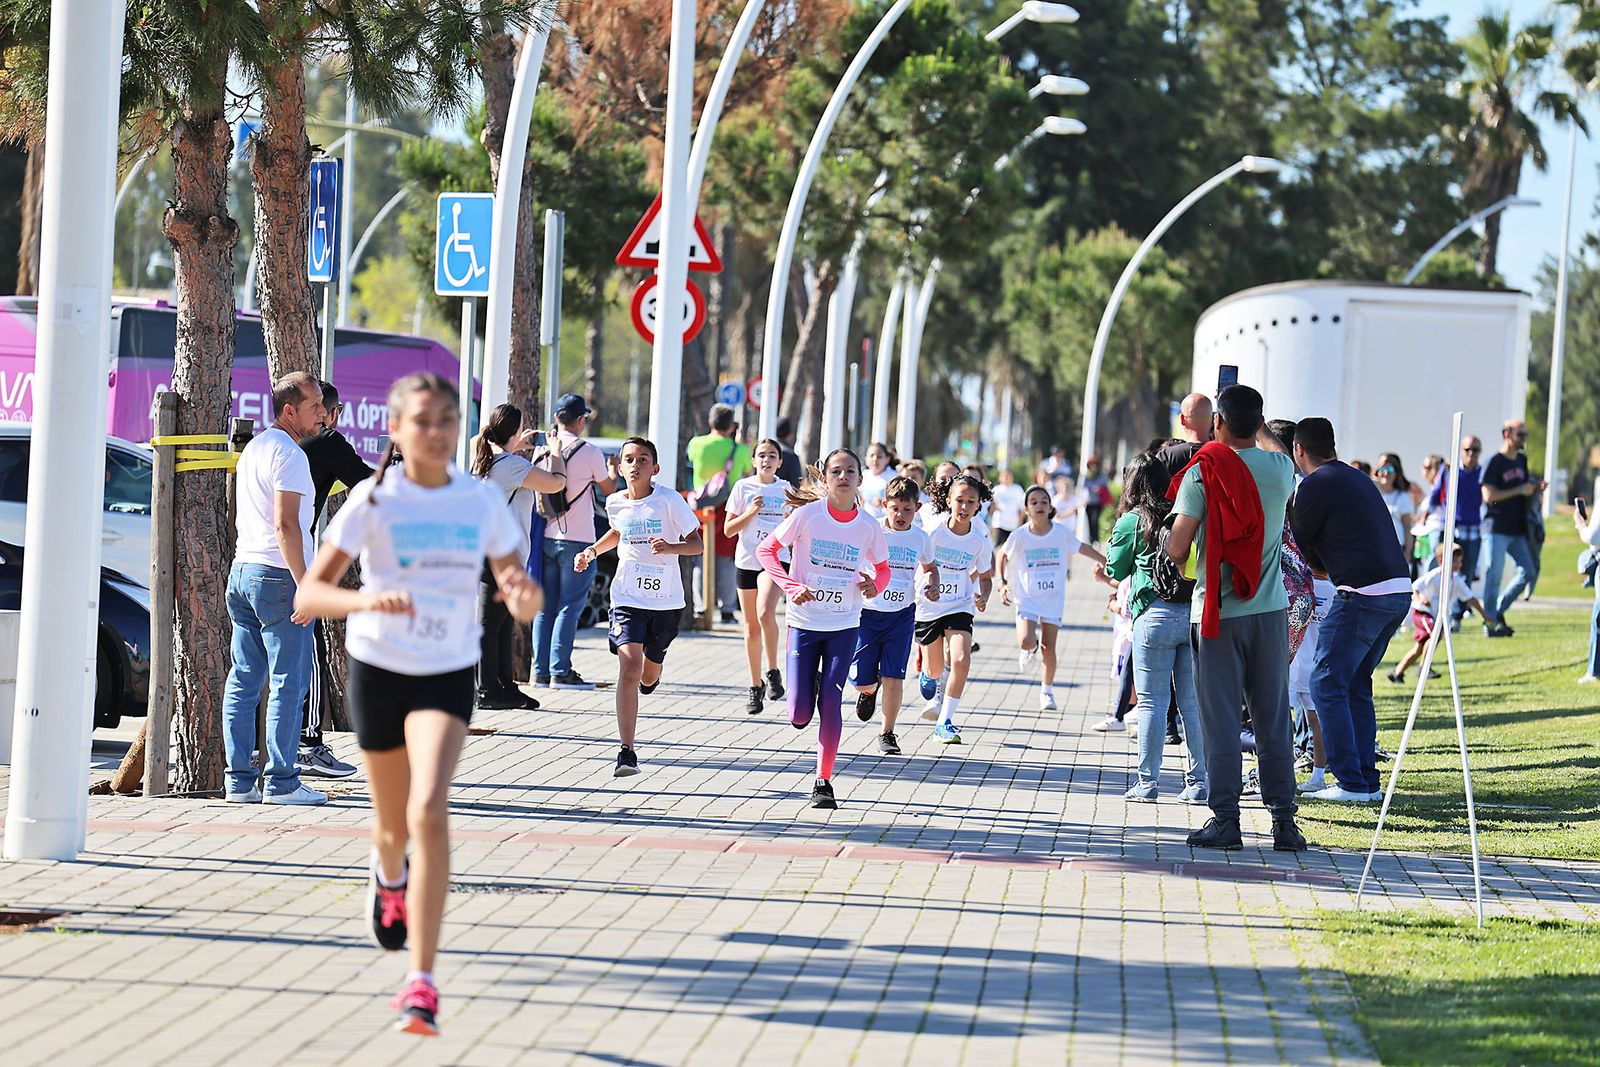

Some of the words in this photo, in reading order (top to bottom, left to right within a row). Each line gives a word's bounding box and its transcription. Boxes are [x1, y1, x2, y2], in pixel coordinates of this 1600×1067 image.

[636, 576, 661, 591] 158
[938, 583, 958, 594] 021
[1038, 581, 1054, 590] 104
[816, 589, 842, 603] 075
[883, 590, 905, 602] 085
